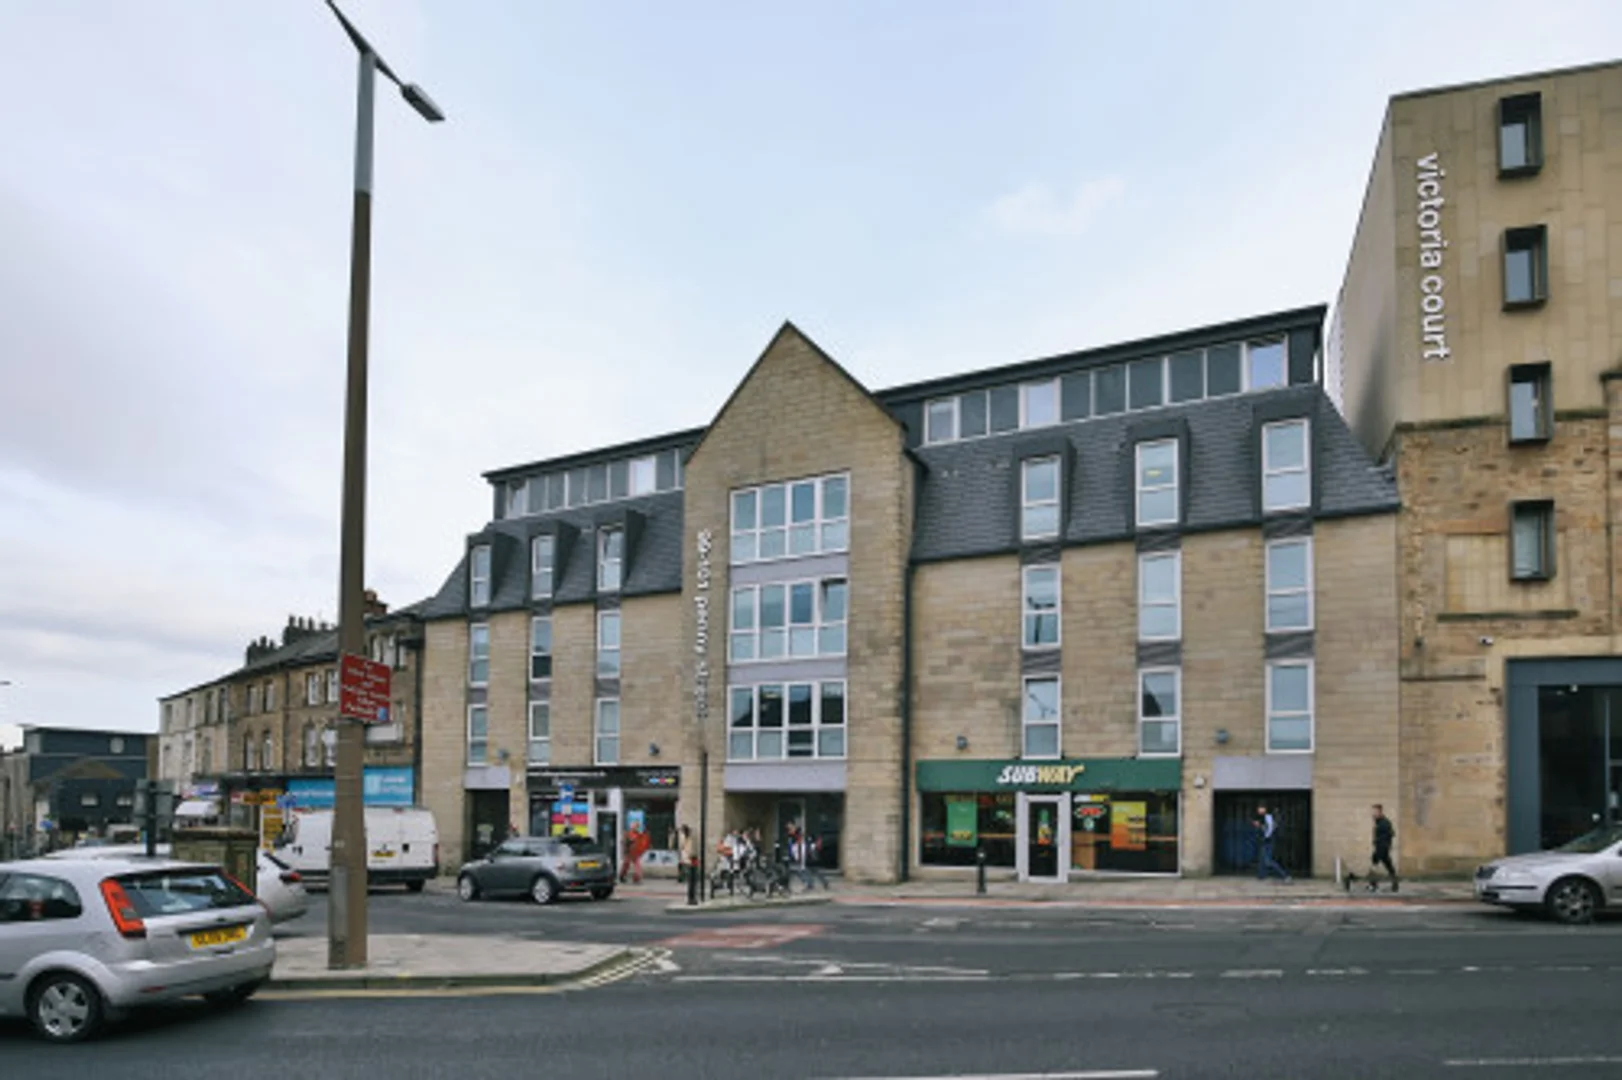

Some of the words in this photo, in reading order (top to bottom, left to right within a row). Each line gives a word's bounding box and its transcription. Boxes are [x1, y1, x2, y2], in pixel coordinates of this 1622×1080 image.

[1416, 152, 1448, 268] victoria
[1420, 275, 1451, 359] court
[694, 597, 709, 653] penny
[996, 764, 1085, 783] SUBWAY
